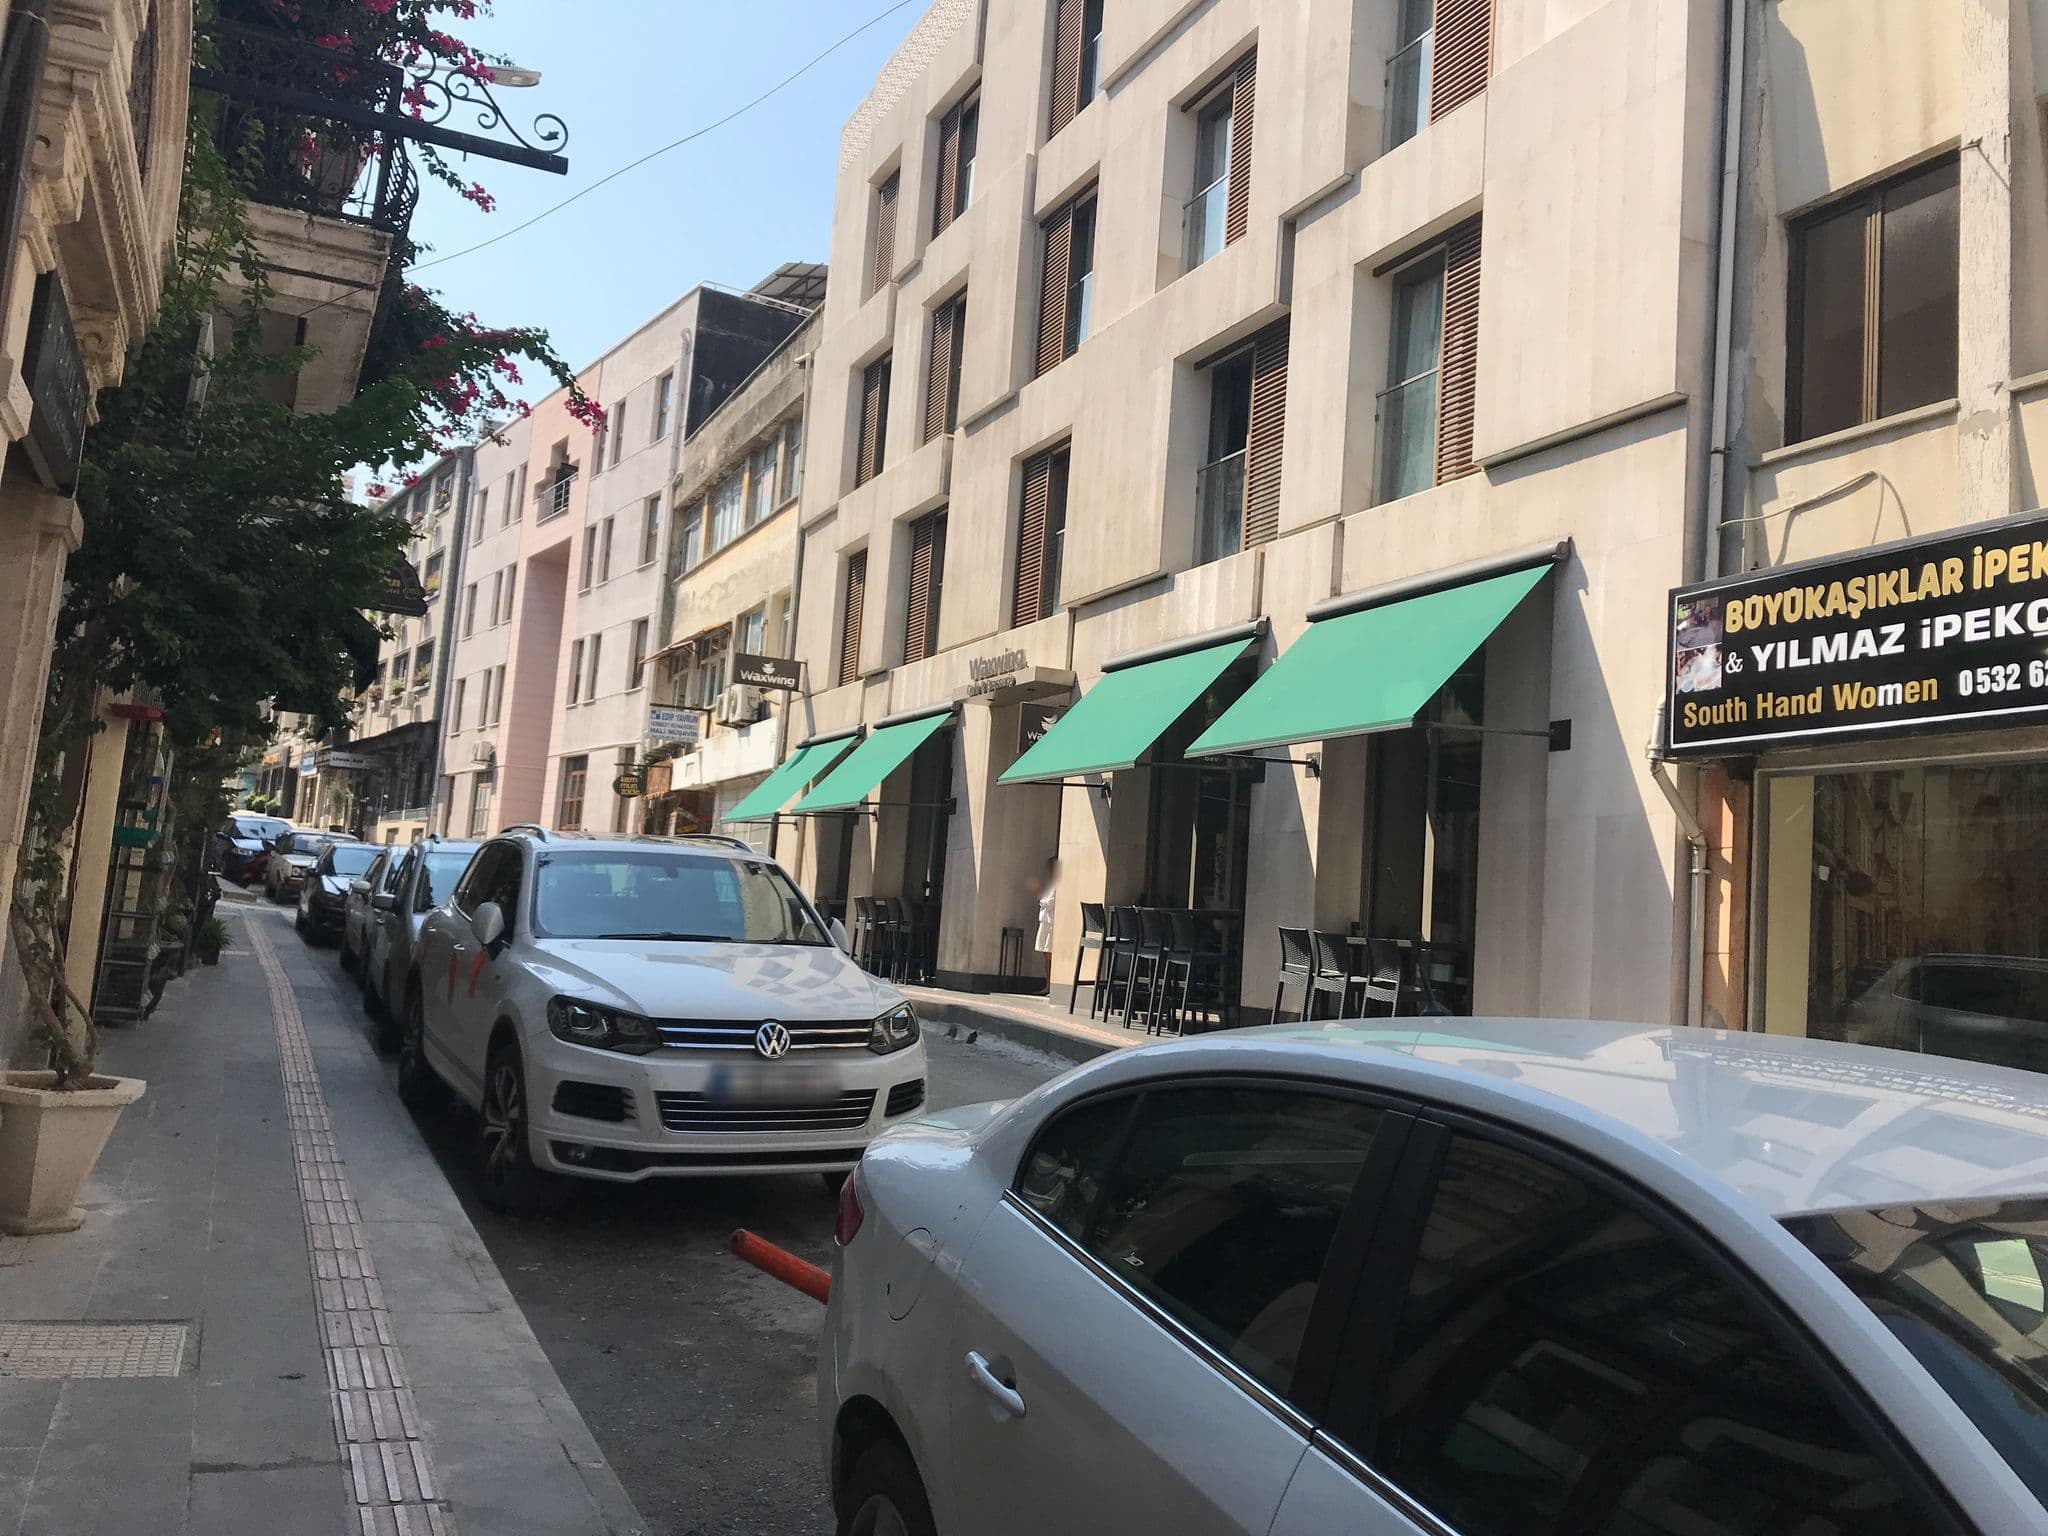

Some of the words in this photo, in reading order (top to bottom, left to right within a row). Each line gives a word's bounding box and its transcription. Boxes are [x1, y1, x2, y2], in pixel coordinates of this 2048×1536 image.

[1725, 652, 1744, 674] &
[1751, 623, 1906, 672] YILMAZ
[740, 670, 796, 688] Waxwing
[2029, 659, 2048, 689] 6
[1683, 697, 1748, 728] South
[1756, 686, 1823, 720] Hand
[1832, 678, 1938, 711] Women
